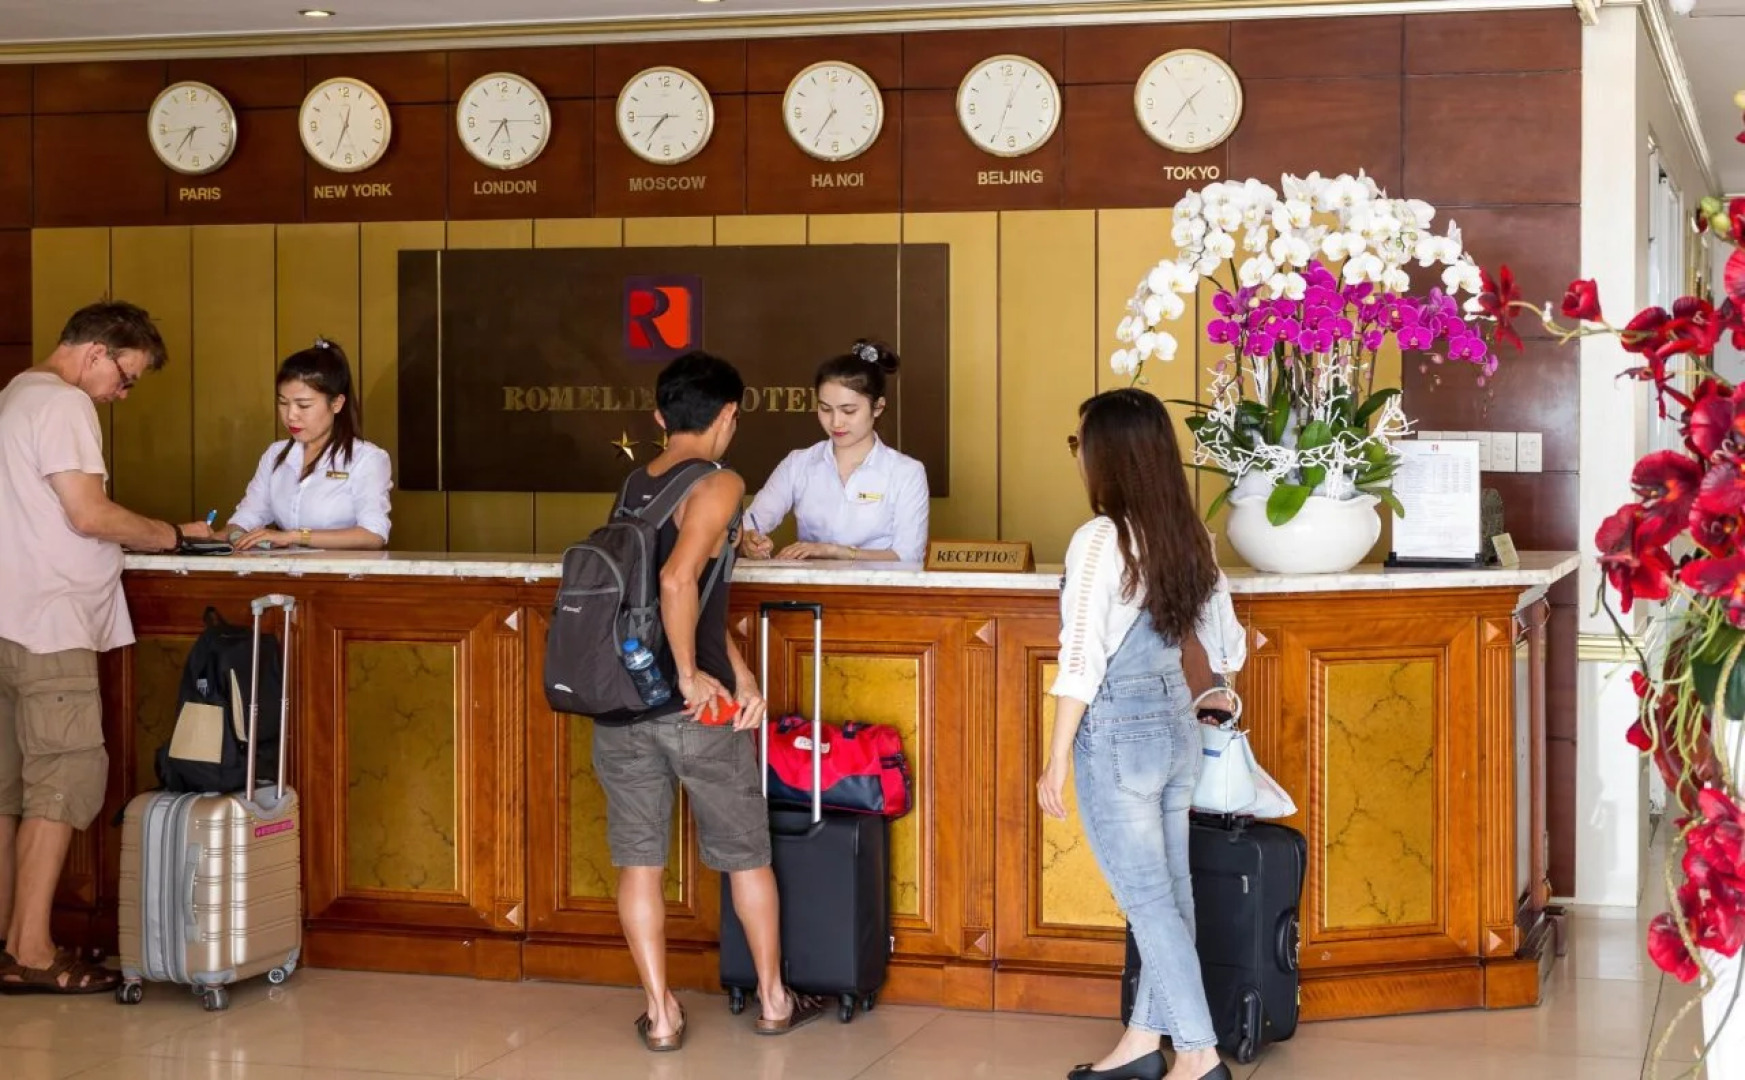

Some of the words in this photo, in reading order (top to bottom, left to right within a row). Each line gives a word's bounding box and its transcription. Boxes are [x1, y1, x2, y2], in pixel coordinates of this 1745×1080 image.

[826, 70, 839, 82] 12
[999, 65, 1013, 76] 12
[496, 81, 508, 93] 12
[658, 76, 670, 87] 12
[185, 90, 196, 101] 12
[338, 87, 349, 98] 12
[977, 169, 1044, 185] BEIJING
[1163, 165, 1220, 180] TOKYO
[474, 180, 537, 195] LONDON
[629, 175, 706, 191] MOSCOW
[179, 187, 222, 200] PARIS
[314, 184, 348, 198] NEW
[352, 183, 392, 197] YORK
[503, 385, 656, 411] ROMELIE
[741, 386, 818, 412] OTE
[937, 550, 1017, 563] RECEPTION
